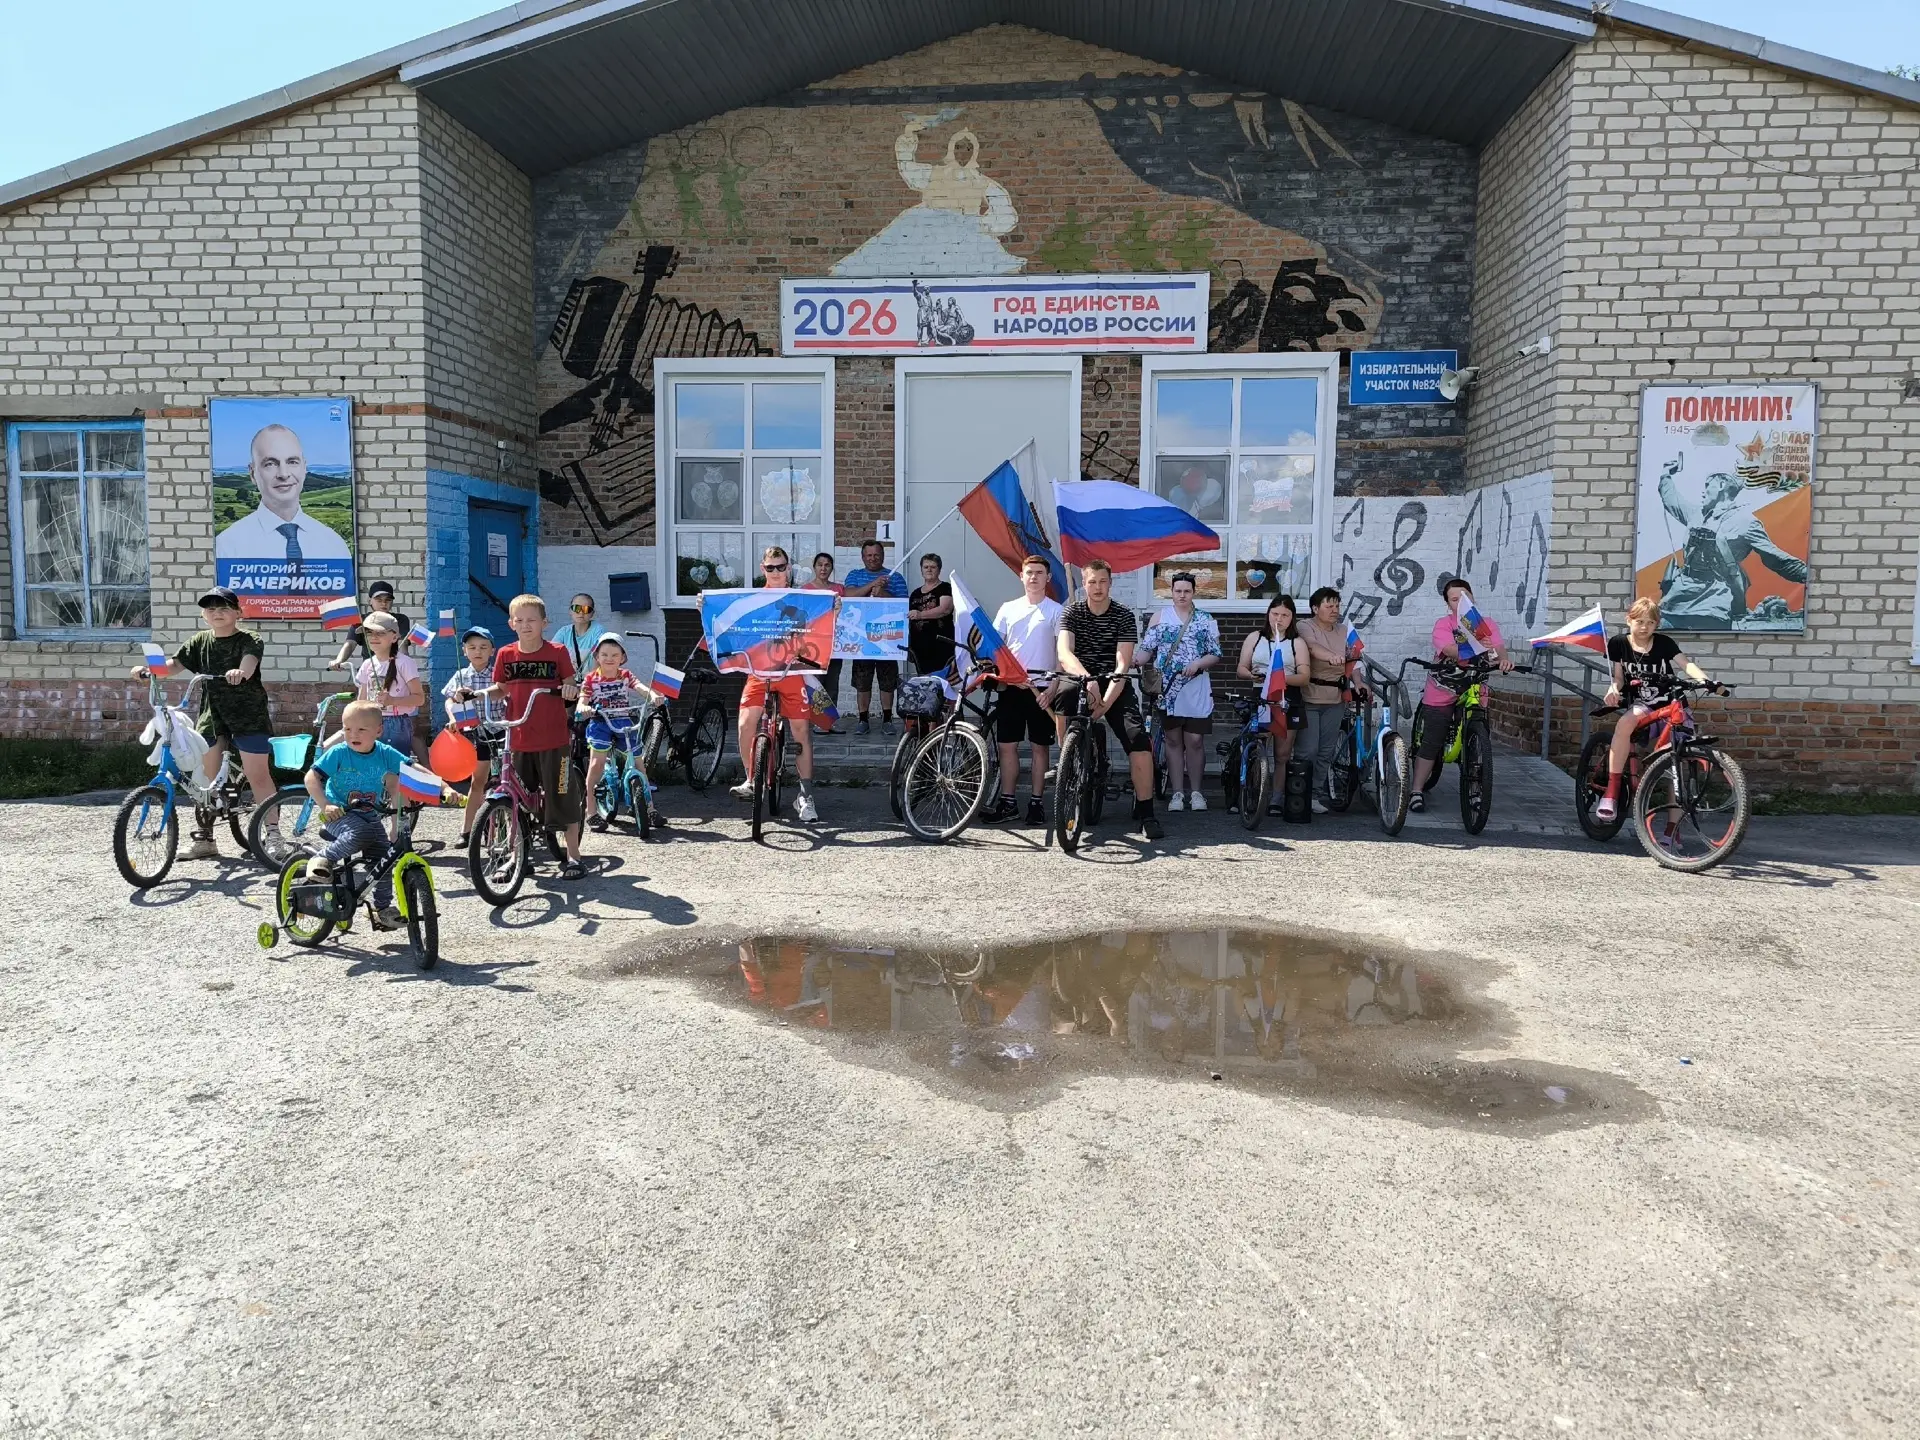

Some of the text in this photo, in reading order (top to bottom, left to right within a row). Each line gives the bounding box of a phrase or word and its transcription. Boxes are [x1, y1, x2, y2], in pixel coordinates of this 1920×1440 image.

[993, 295, 1160, 315] ГОД ЕДИНСТВА
[793, 298, 897, 336] 2026
[993, 316, 1196, 335] НАРОДОВ РОССИИ
[1360, 361, 1447, 375] ИЗБИРАТЕЛЬНЫЙ
[1365, 380, 1410, 391] УЧАСТОК
[1665, 396, 1793, 422] ПОМНИМ!
[1772, 431, 1810, 444] 9 МАЯ
[882, 523, 891, 539] 1
[229, 562, 297, 574] ГРИГОРИЙ
[228, 576, 346, 591] БАЧЕРИКОВ
[800, 686, 809, 704] 9
[365, 846, 396, 884] STAR
